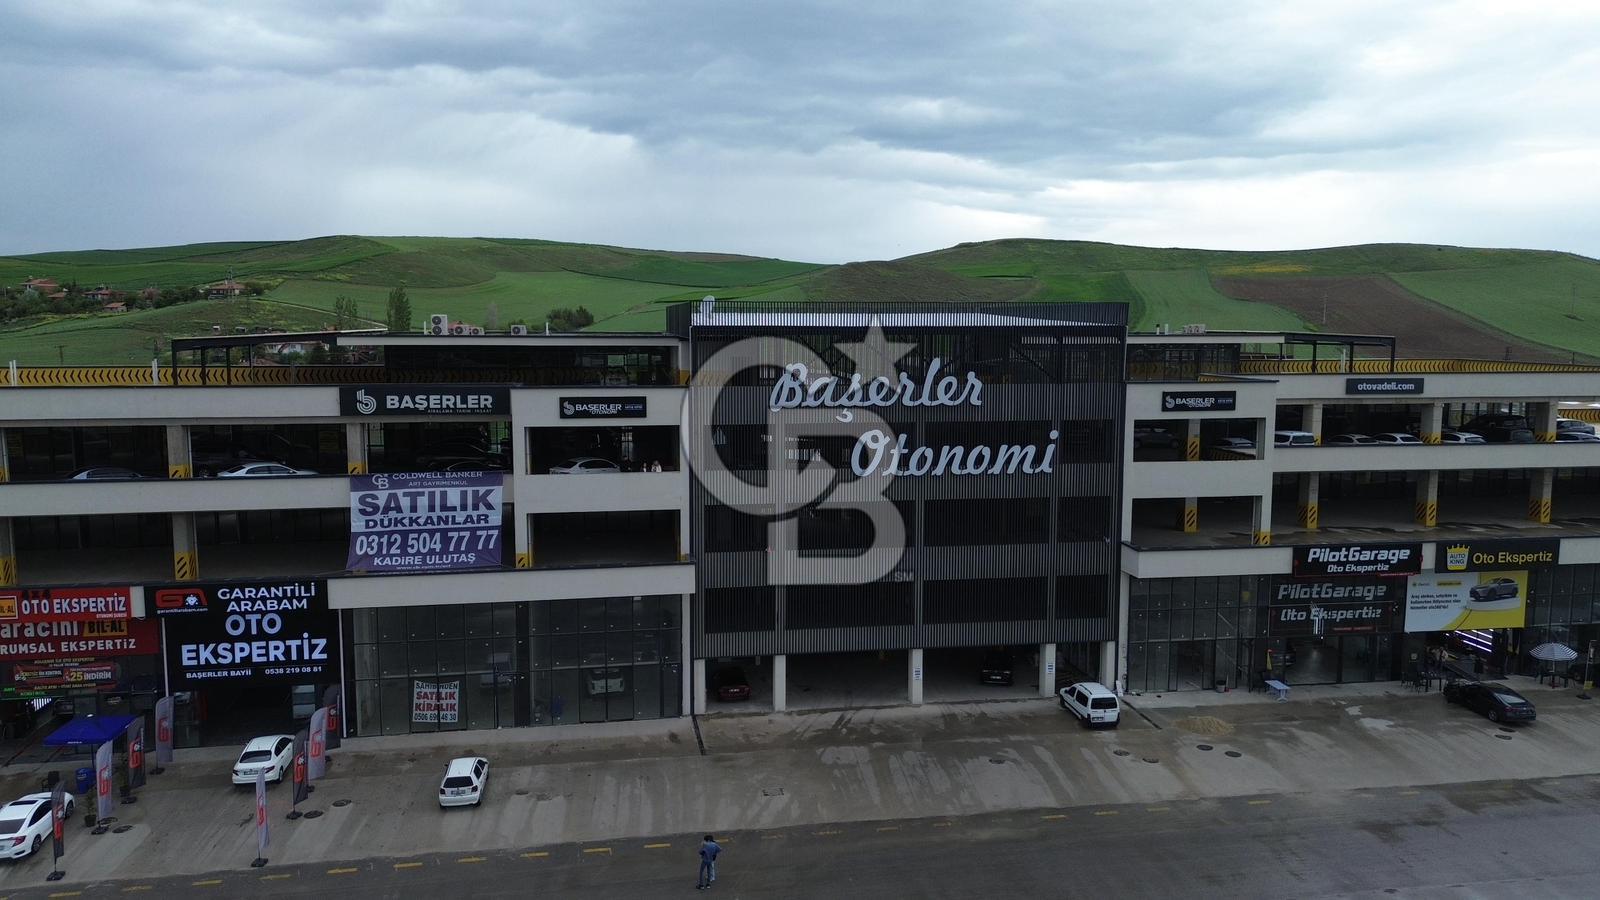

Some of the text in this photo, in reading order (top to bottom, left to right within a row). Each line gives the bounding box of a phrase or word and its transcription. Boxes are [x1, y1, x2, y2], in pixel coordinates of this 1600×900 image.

[770, 356, 983, 423] Başerler
[1357, 381, 1415, 391] otovadeli.com
[386, 394, 493, 410] BAŞERLER
[850, 428, 1059, 477] Otonomi
[392, 471, 483, 480] COLDWELL BANKER
[358, 489, 496, 516] SATILIK
[365, 513, 489, 530] DÜKKANLAR
[355, 529, 498, 556] 0312 504 77 77
[373, 553, 476, 566] KADİRE ULUTAŞ
[1308, 547, 1410, 563] PilotGarage
[1473, 550, 1552, 565] Oto Ekspertiz
[1327, 563, 1389, 573] Oto Ekspertiz
[217, 582, 315, 599] GARANTİLİ
[1278, 583, 1387, 600] PilotGarage
[21, 592, 126, 615] OTO EKSPERTİZ
[227, 599, 307, 612] ARABAM
[1280, 607, 1382, 622] Oto Ekspertiz
[225, 612, 282, 636] OTO
[61, 638, 136, 652] EKSPERTİZ
[181, 632, 328, 666] EKSPERTİZ
[186, 670, 228, 679] BAŞERLER
[415, 682, 458, 690] SAHİBNDEN
[416, 691, 456, 700] SATILIK
[415, 701, 456, 712] KİRALIK
